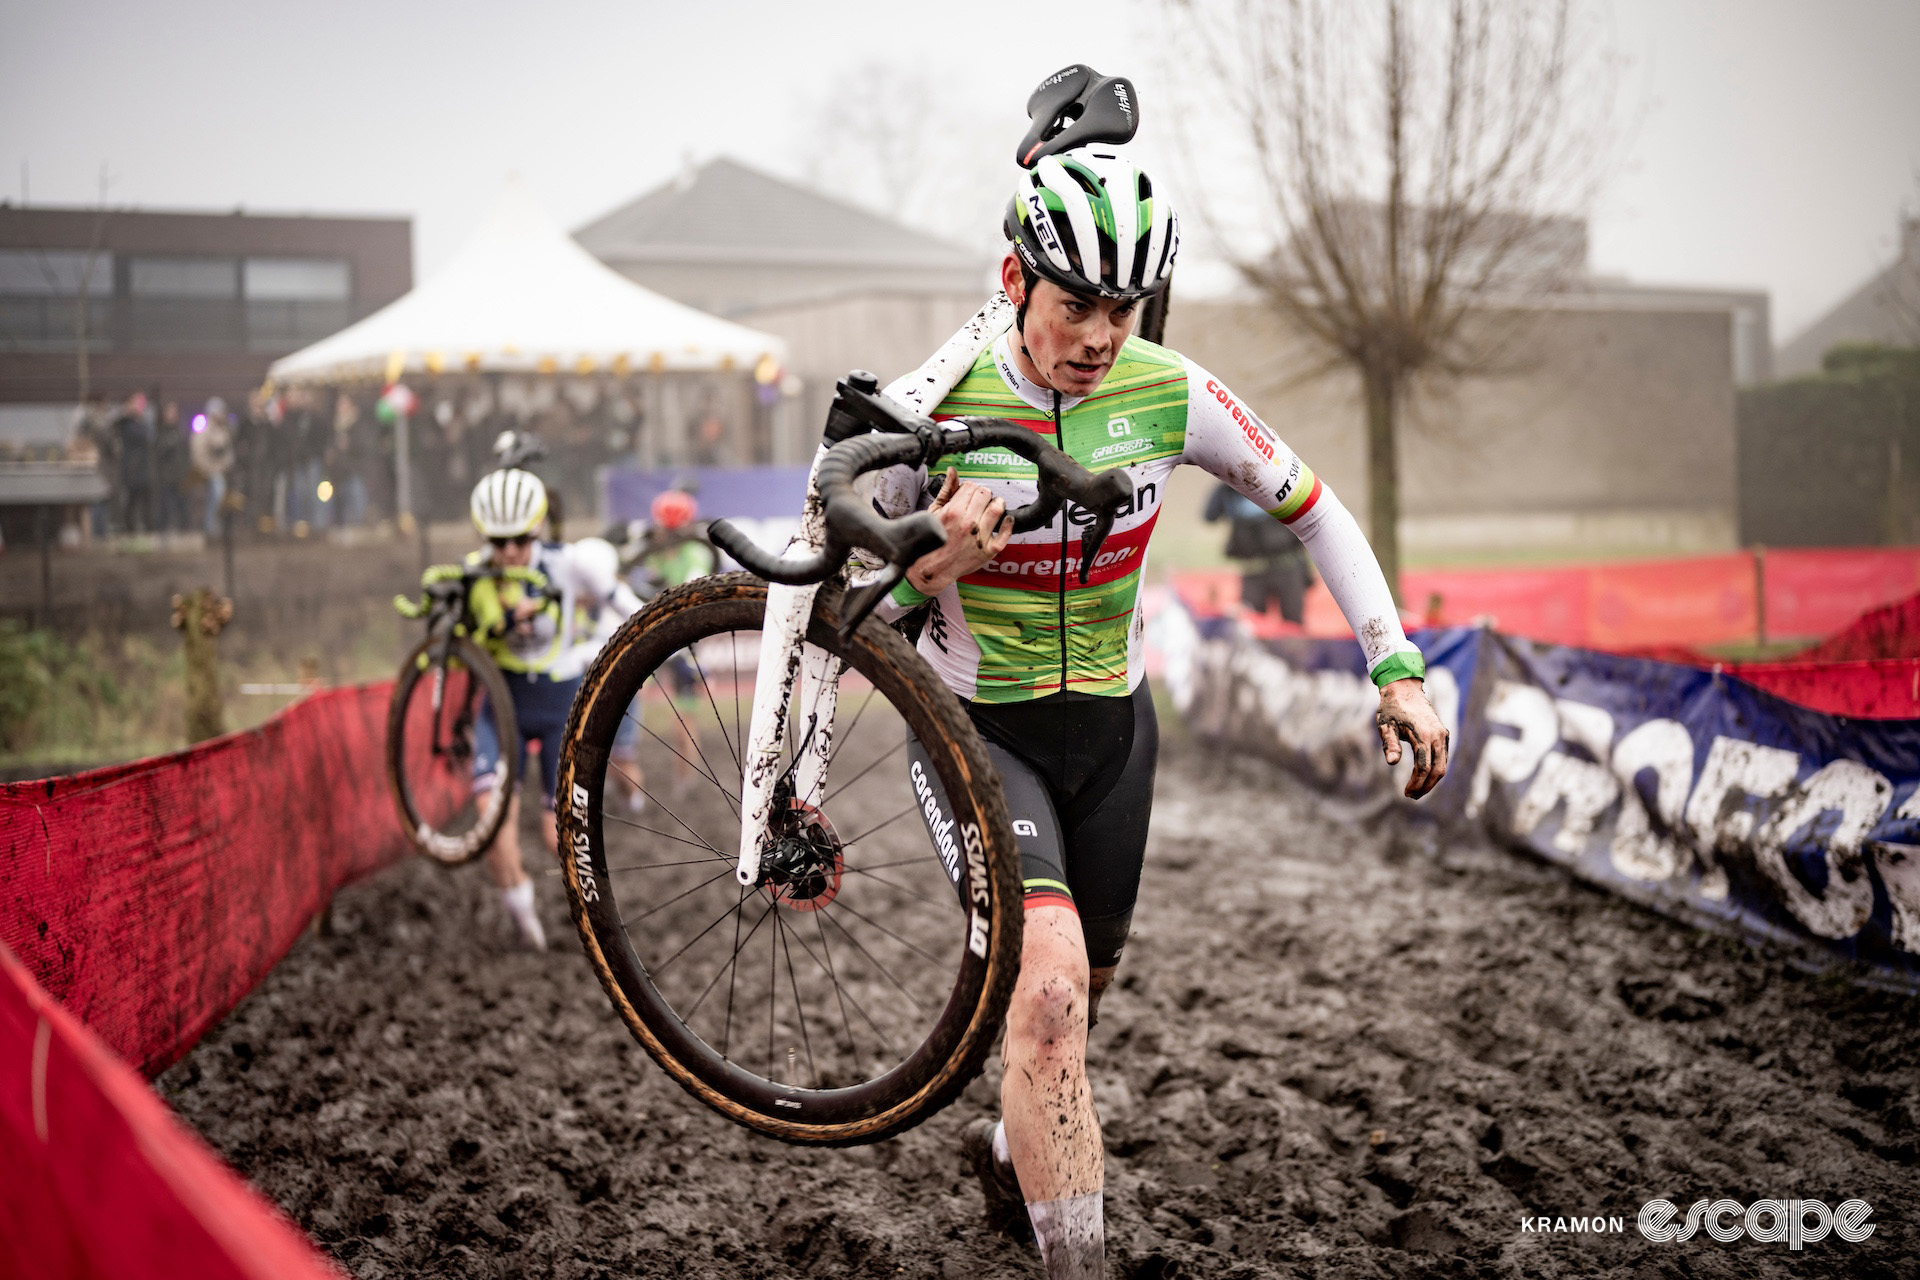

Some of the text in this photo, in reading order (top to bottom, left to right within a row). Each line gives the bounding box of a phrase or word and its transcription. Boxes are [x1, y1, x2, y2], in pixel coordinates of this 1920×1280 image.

[1029, 195, 1063, 255] MET
[1019, 243, 1037, 268] crelan
[1001, 363, 1020, 390] crelan
[964, 452, 1034, 467] FRISTADS
[1275, 479, 1292, 502] DT
[572, 781, 600, 903] DT SWISS
[961, 822, 990, 960] DT SWISS
